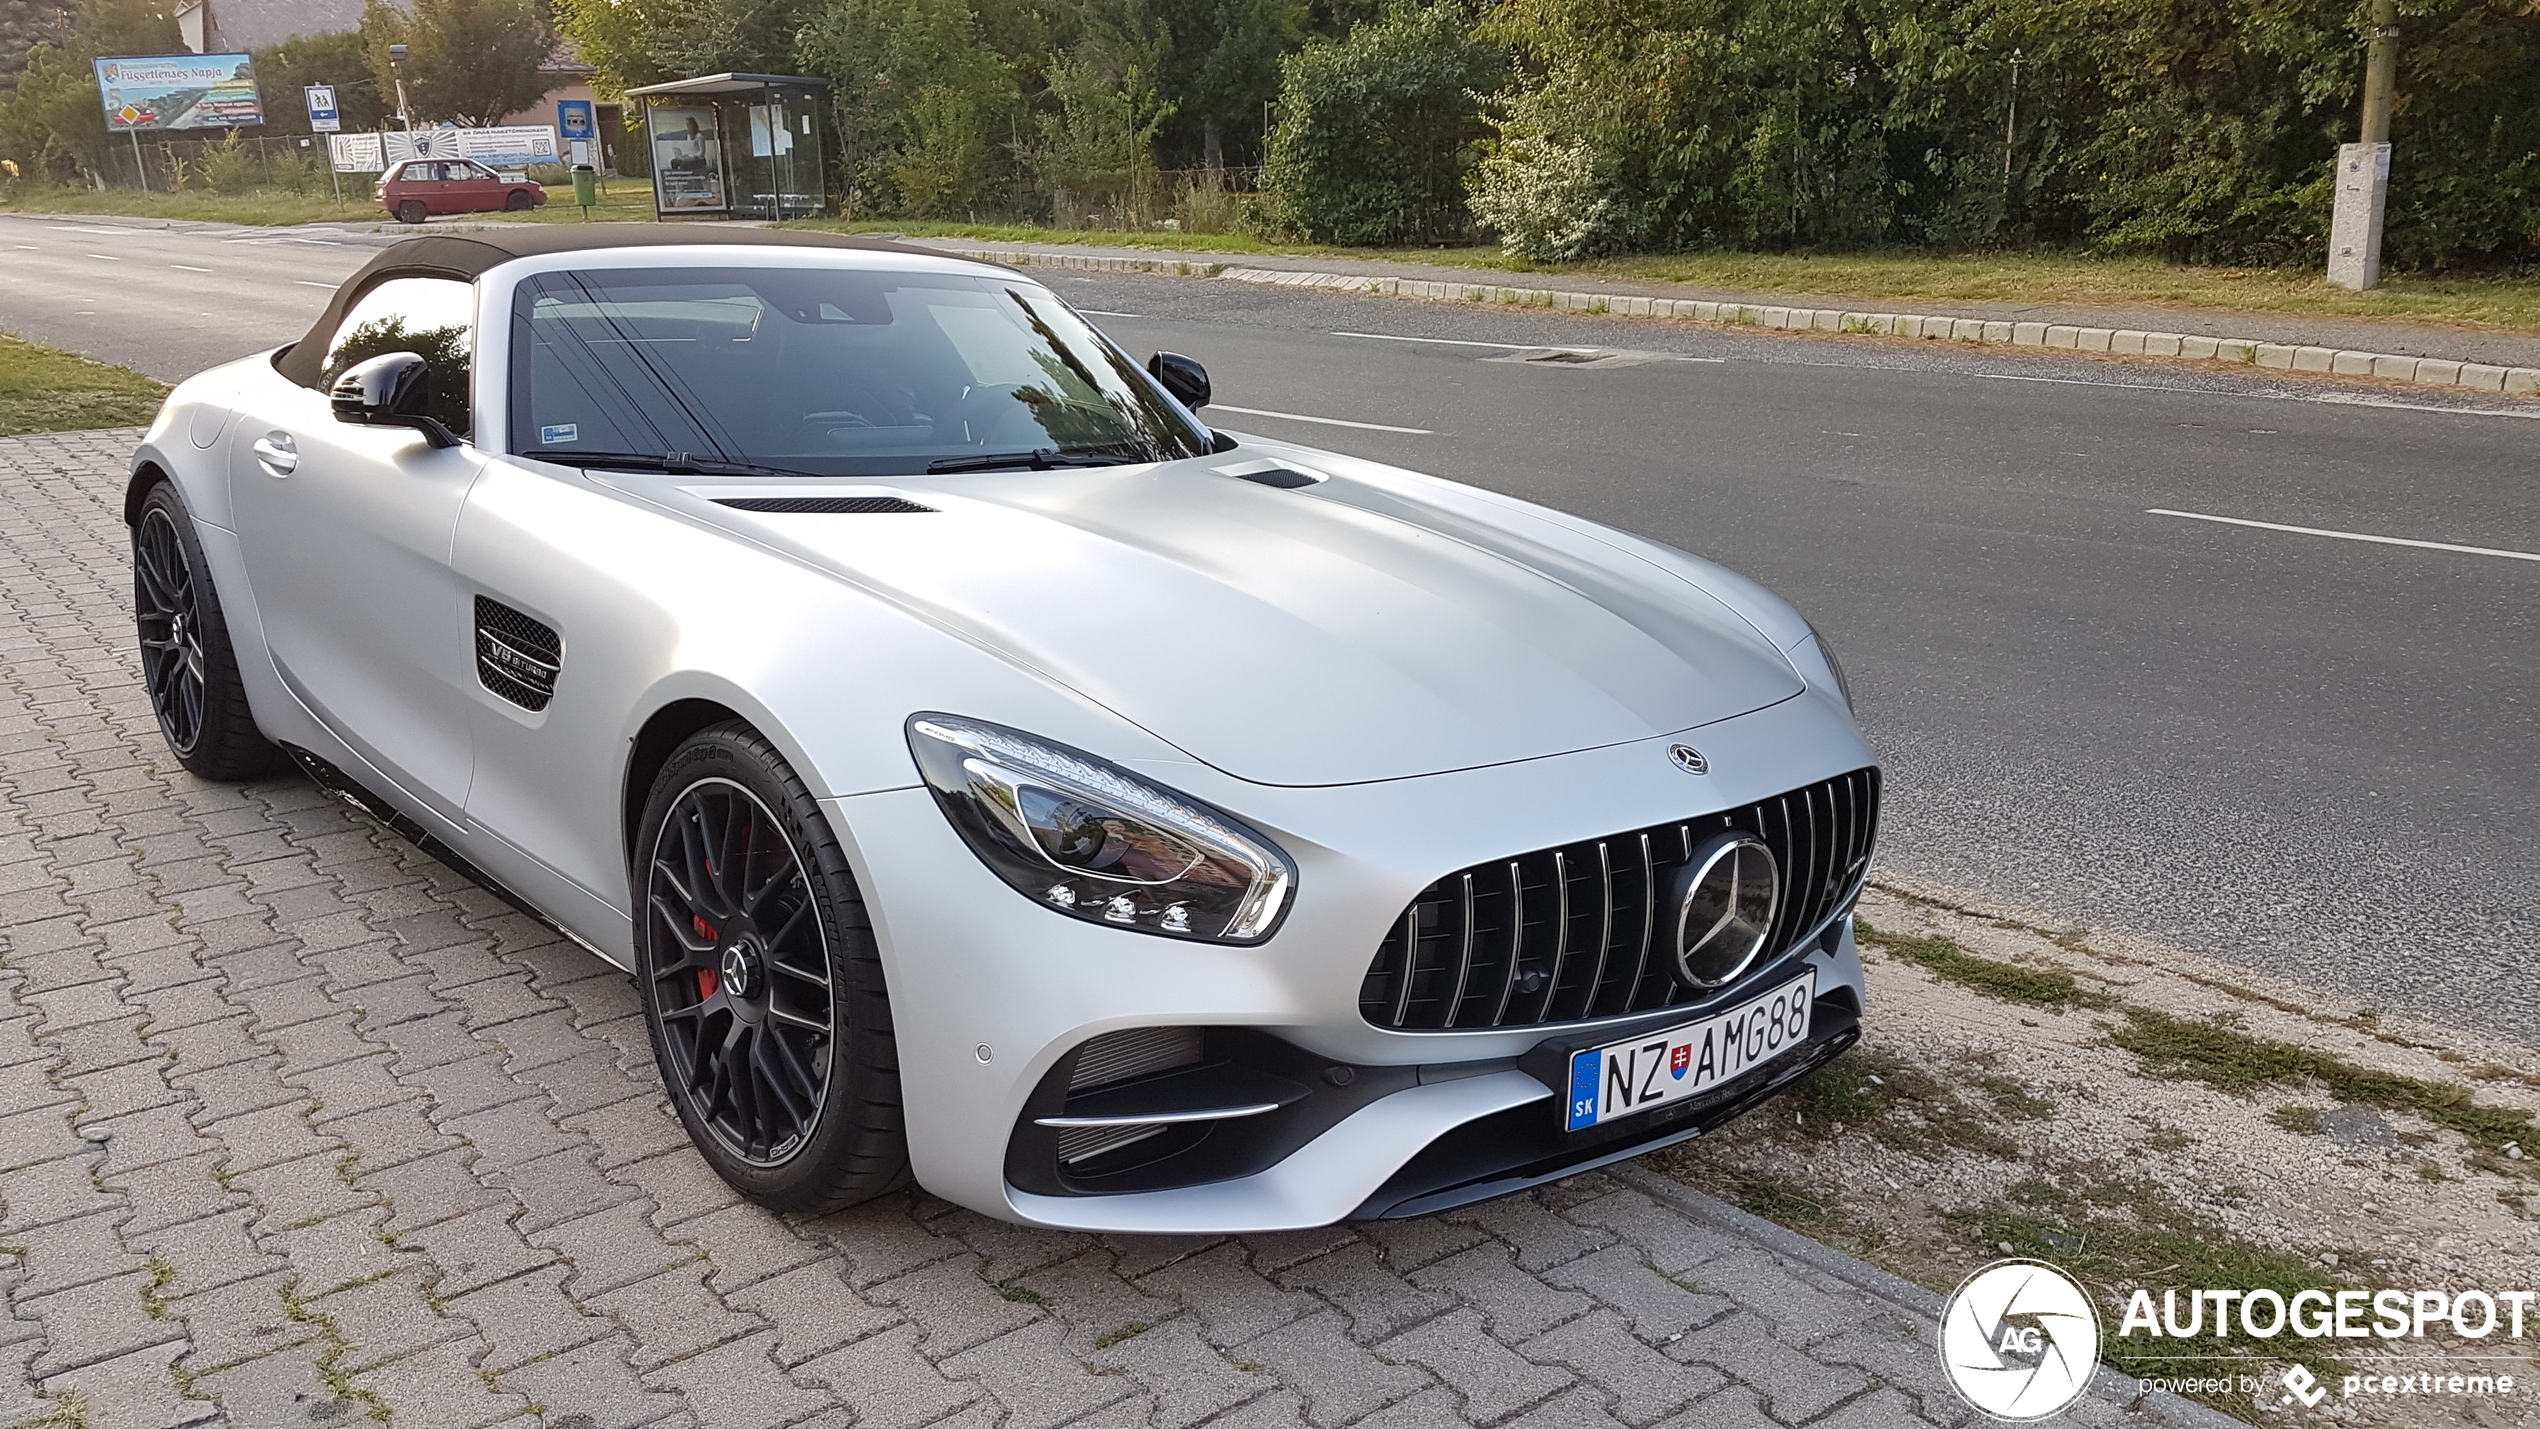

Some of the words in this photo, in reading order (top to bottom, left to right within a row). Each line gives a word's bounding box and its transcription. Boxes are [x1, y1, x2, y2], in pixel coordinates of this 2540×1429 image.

[191, 67, 223, 79] Napja
[813, 874, 849, 1003] MICHELIN
[1605, 1039, 1669, 1114] NZ
[1692, 984, 1807, 1088] AMG88
[1575, 1098, 1594, 1117] SK
